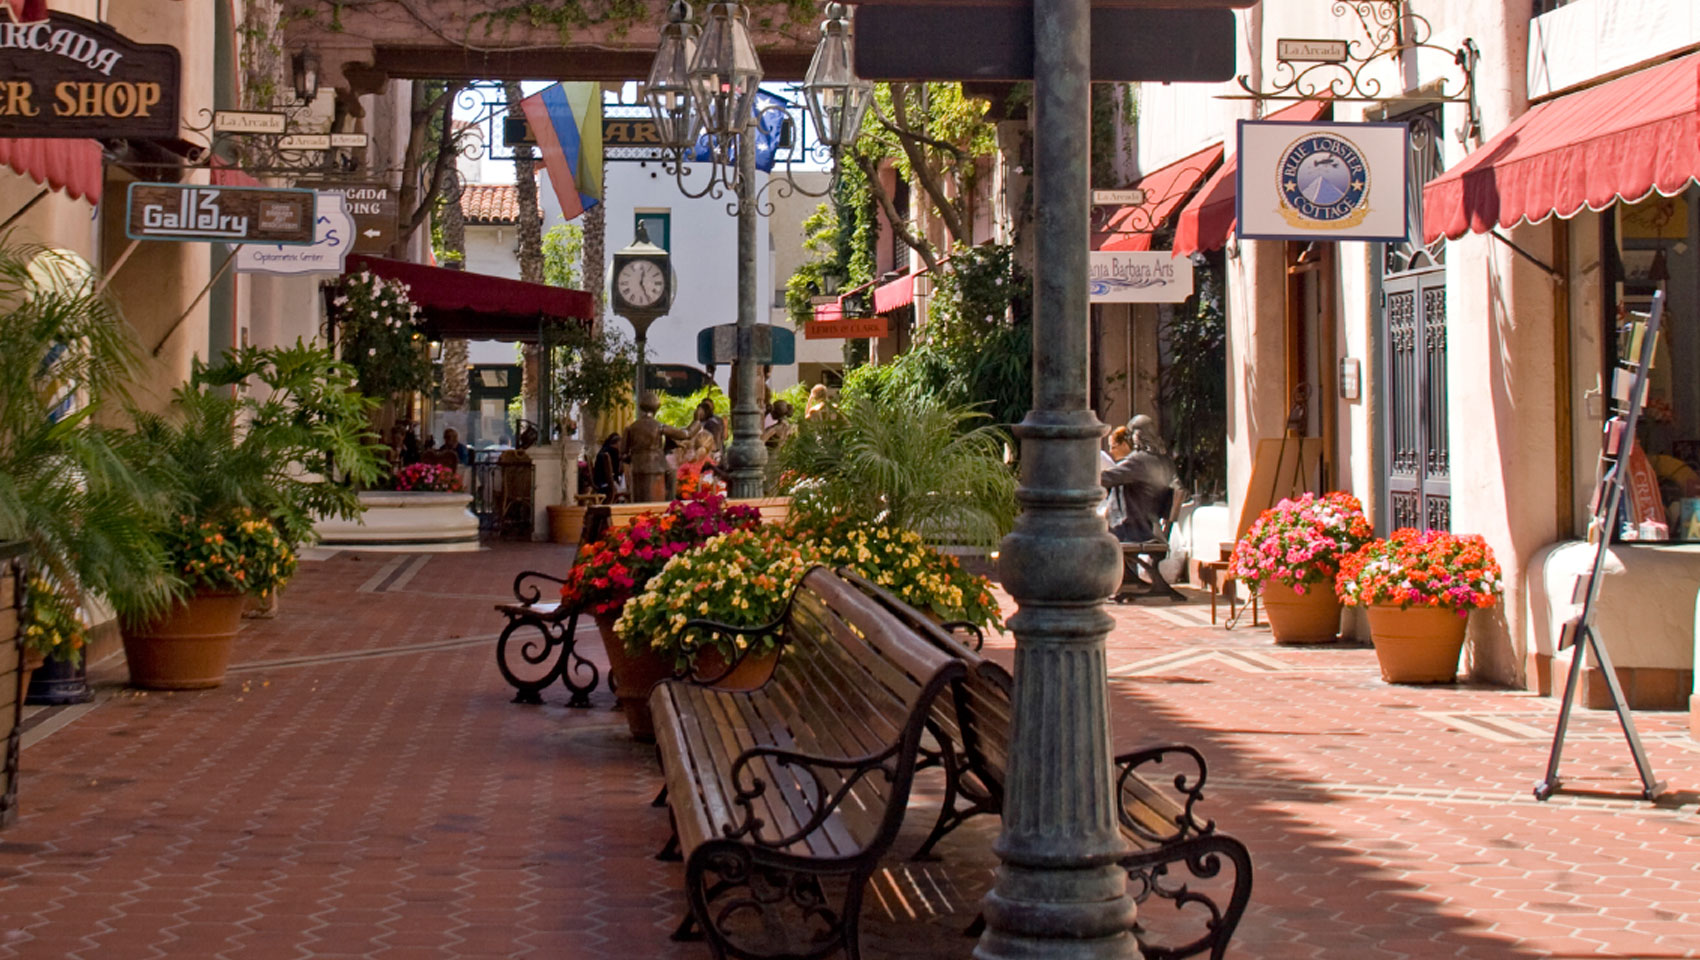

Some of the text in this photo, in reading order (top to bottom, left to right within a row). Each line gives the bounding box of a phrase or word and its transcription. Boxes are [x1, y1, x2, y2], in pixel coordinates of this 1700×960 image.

[1284, 43, 1341, 56] La Arcada
[52, 81, 161, 117] SHOP
[219, 115, 280, 129] La Arcada
[1284, 139, 1363, 177] BLUE LOBSTER
[1096, 192, 1140, 202] La Arcada
[1294, 196, 1356, 219] COTTAGE
[253, 251, 298, 265] Optometric
[1111, 257, 1152, 278] Barbara
[1152, 258, 1175, 278] Arts
[811, 324, 839, 334] LEWIS
[850, 323, 881, 333] CLARK
